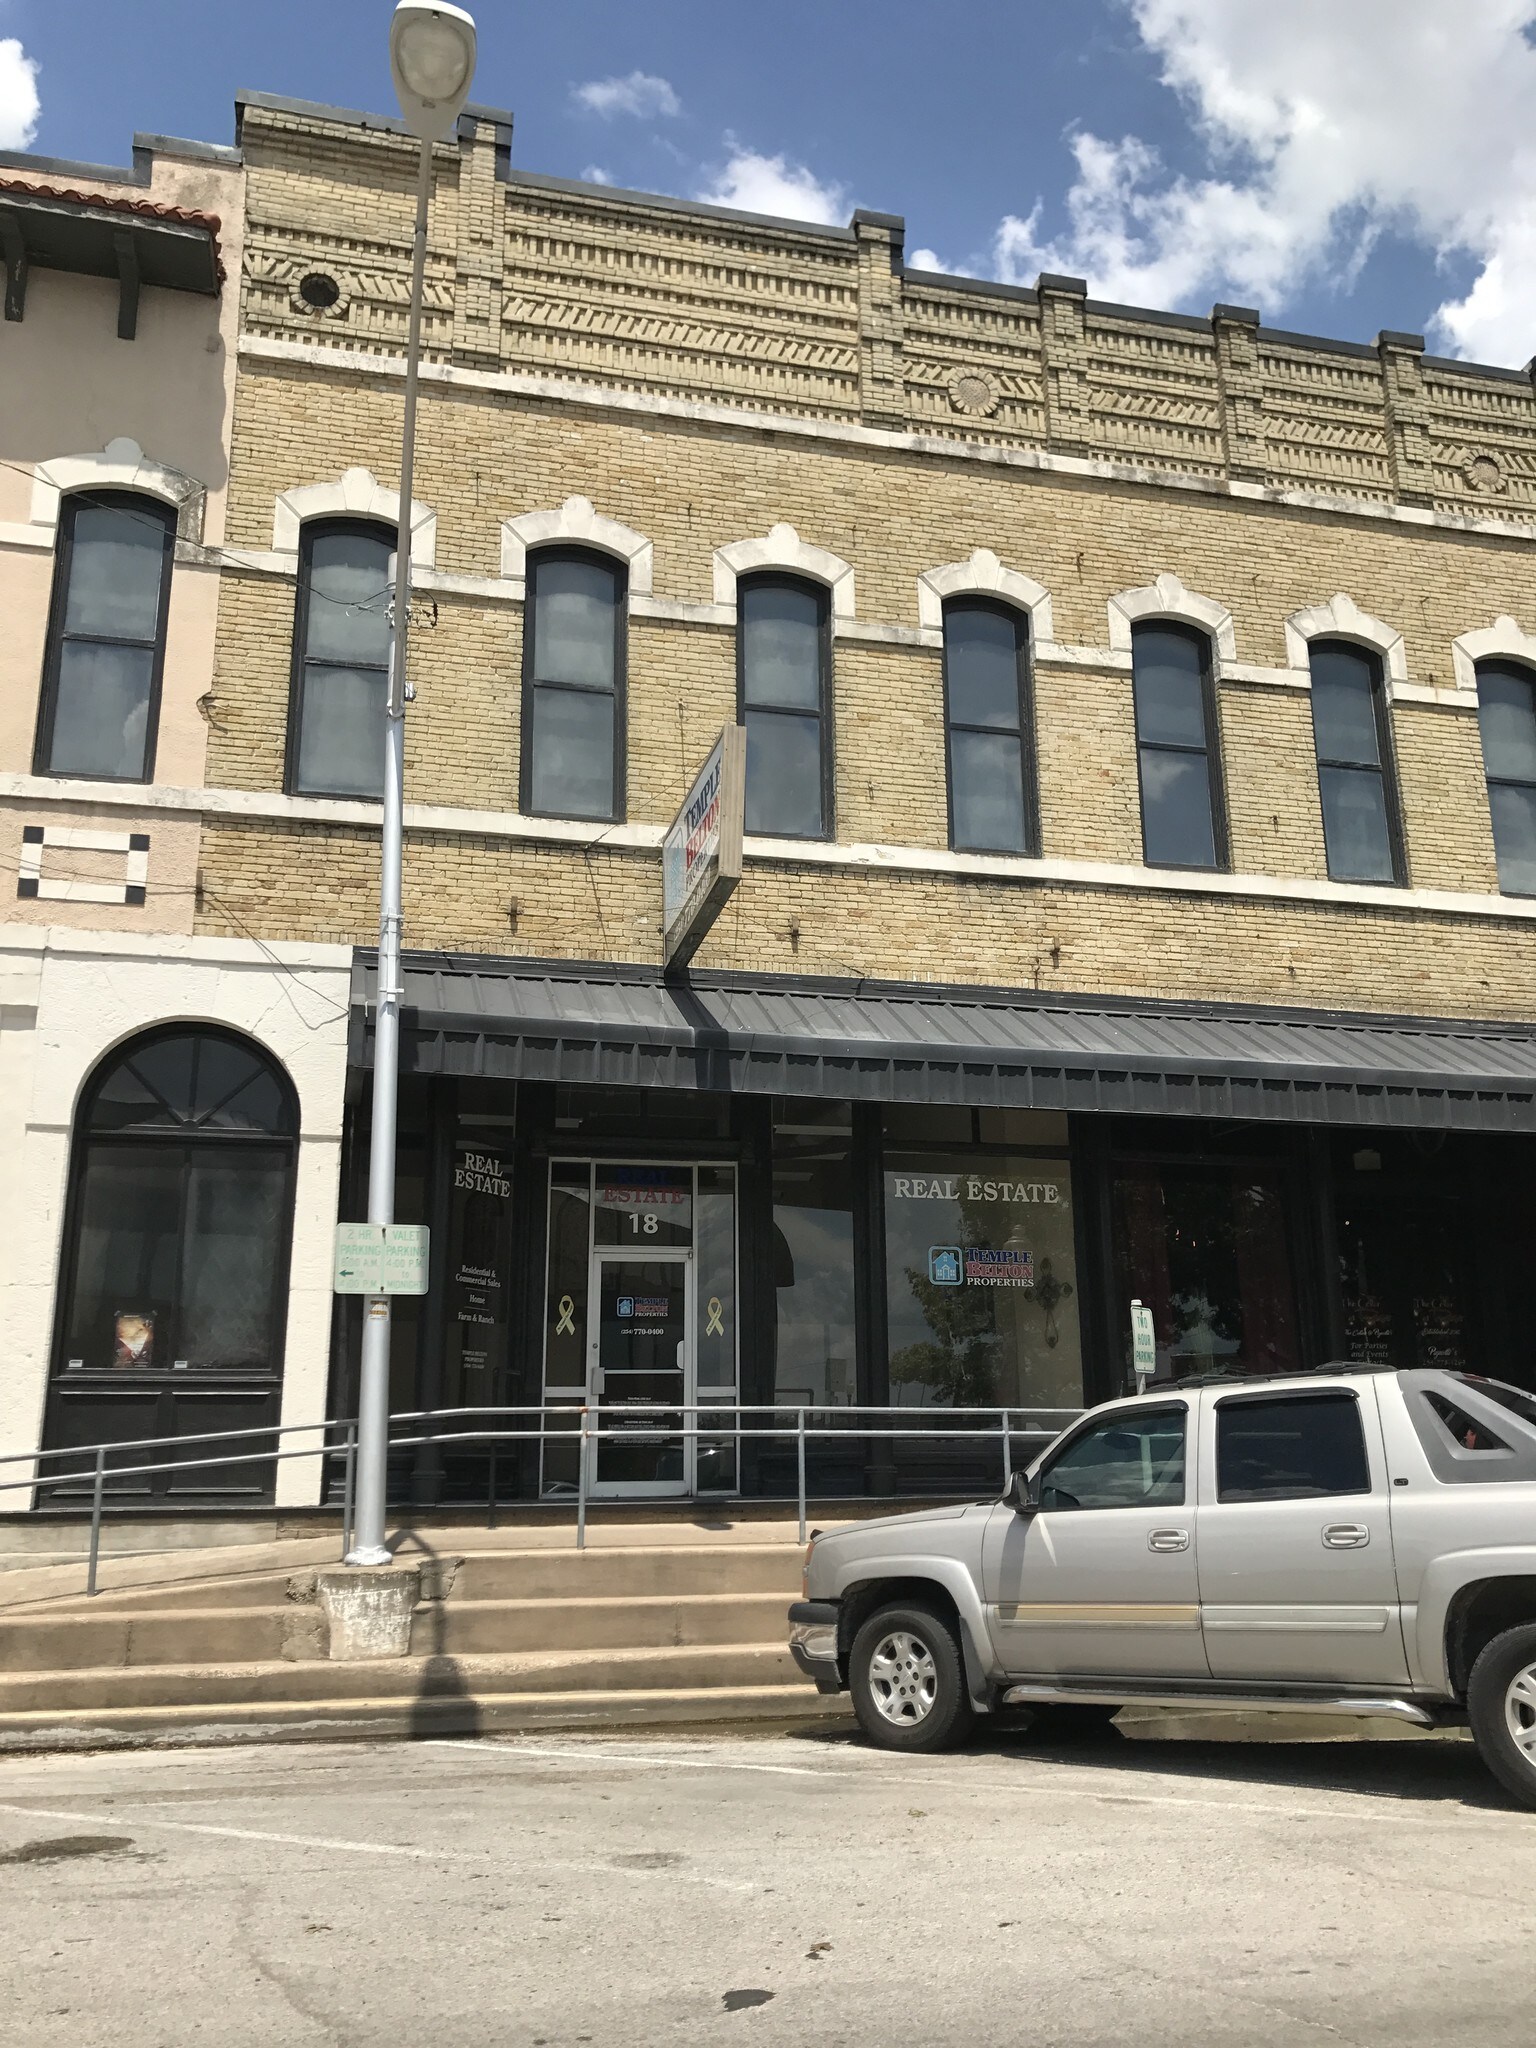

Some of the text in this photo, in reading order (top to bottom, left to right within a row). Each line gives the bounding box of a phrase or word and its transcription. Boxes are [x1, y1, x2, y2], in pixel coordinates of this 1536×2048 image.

[684, 759, 721, 841] TEMPLE
[686, 794, 720, 872] BELTON
[464, 1152, 503, 1178] REAL
[454, 1168, 511, 1198] ESTATE
[603, 1186, 684, 1204] ESTATE
[894, 1178, 1059, 1203] REAL ESTATE
[628, 1213, 659, 1234] 18
[347, 1229, 372, 1240] 2 HR
[393, 1230, 421, 1241] VALET
[340, 1245, 381, 1256] PARKING
[386, 1245, 426, 1257] PARKING
[965, 1247, 1033, 1264] TEMPLE
[461, 1265, 497, 1278] Residential &
[965, 1261, 1034, 1278] BELTON
[455, 1273, 501, 1288] Commercial Sales
[966, 1277, 1035, 1287] PROPERTIES
[457, 1311, 495, 1324] Farm & Ranch
[1136, 1316, 1148, 1328] TWO
[1137, 1333, 1151, 1345] HOUR
[1136, 1351, 1154, 1364] PARKING
